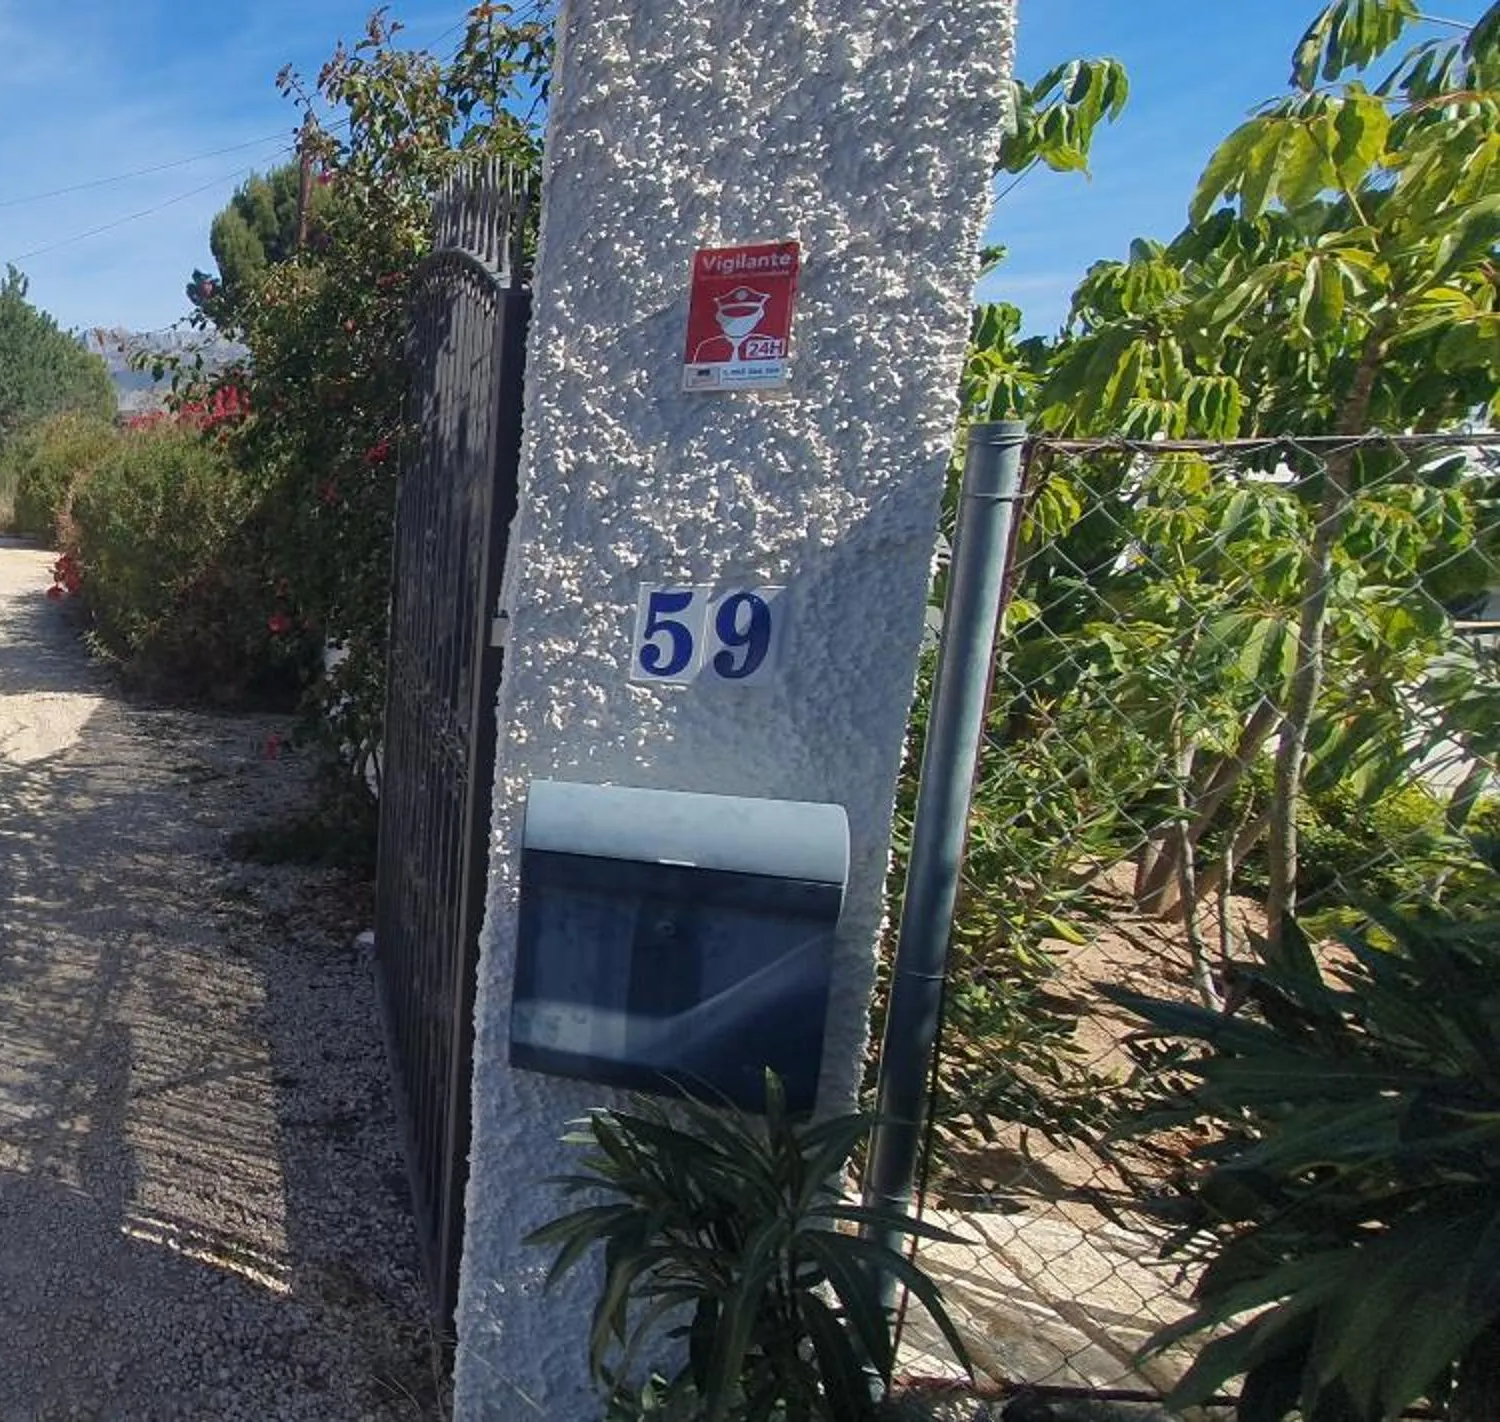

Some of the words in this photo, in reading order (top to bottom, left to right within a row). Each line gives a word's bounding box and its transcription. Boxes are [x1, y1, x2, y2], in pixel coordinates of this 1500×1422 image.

[703, 253, 791, 274] Vigilante
[748, 341, 783, 357] 24H
[639, 592, 772, 679] 59
